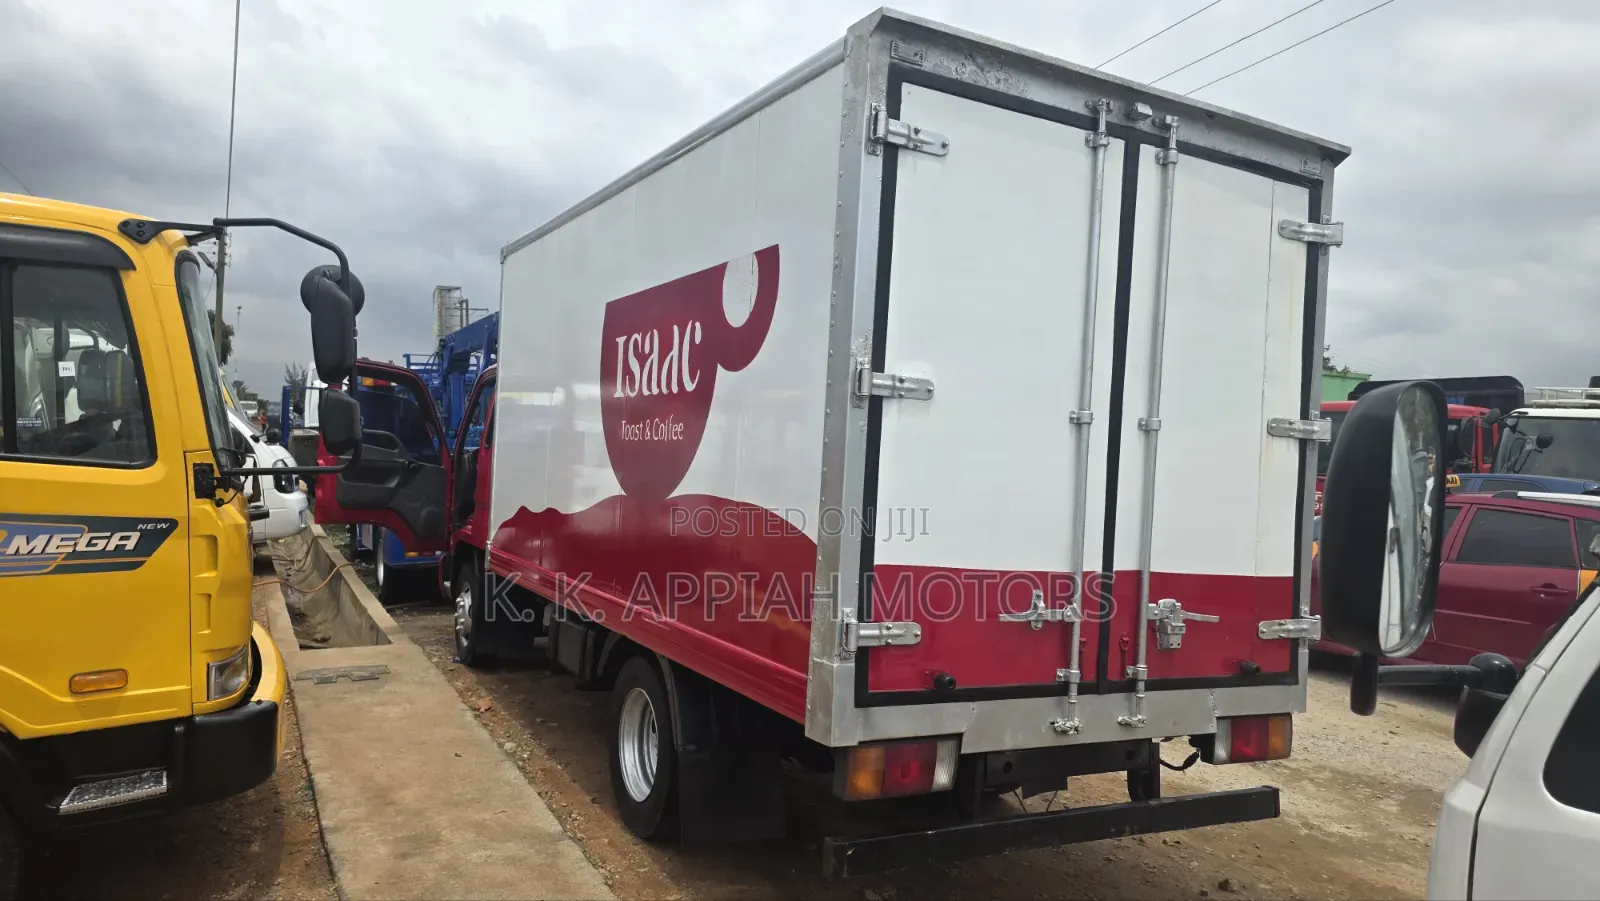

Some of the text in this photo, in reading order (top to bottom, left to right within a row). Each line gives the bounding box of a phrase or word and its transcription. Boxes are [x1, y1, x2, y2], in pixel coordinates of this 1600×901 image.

[644, 419, 651, 440] &
[652, 413, 684, 442] Coffee
[137, 522, 170, 530] NEW
[6, 531, 141, 555] MEGA
